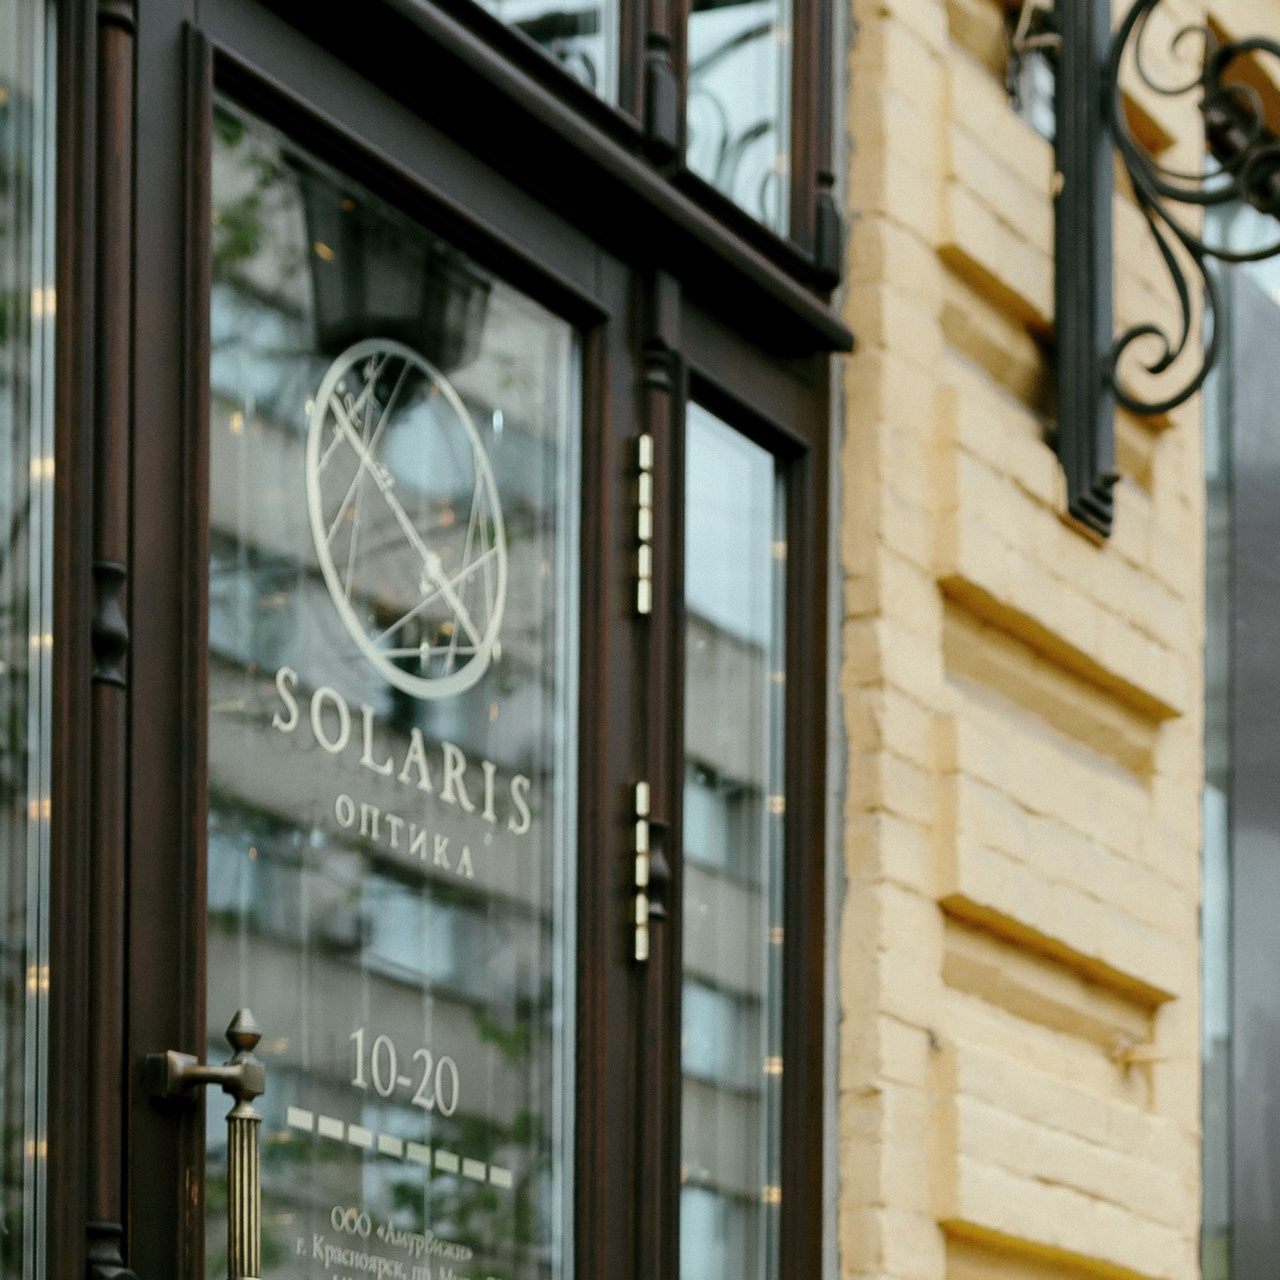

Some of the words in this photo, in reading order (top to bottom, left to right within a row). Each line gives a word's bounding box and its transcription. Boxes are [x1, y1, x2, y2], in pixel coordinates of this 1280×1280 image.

[272, 666, 532, 834] SOLARIS
[334, 794, 475, 879] ОПТИКА
[350, 1028, 460, 1117] 10-20
[331, 1206, 372, 1238] ООО
